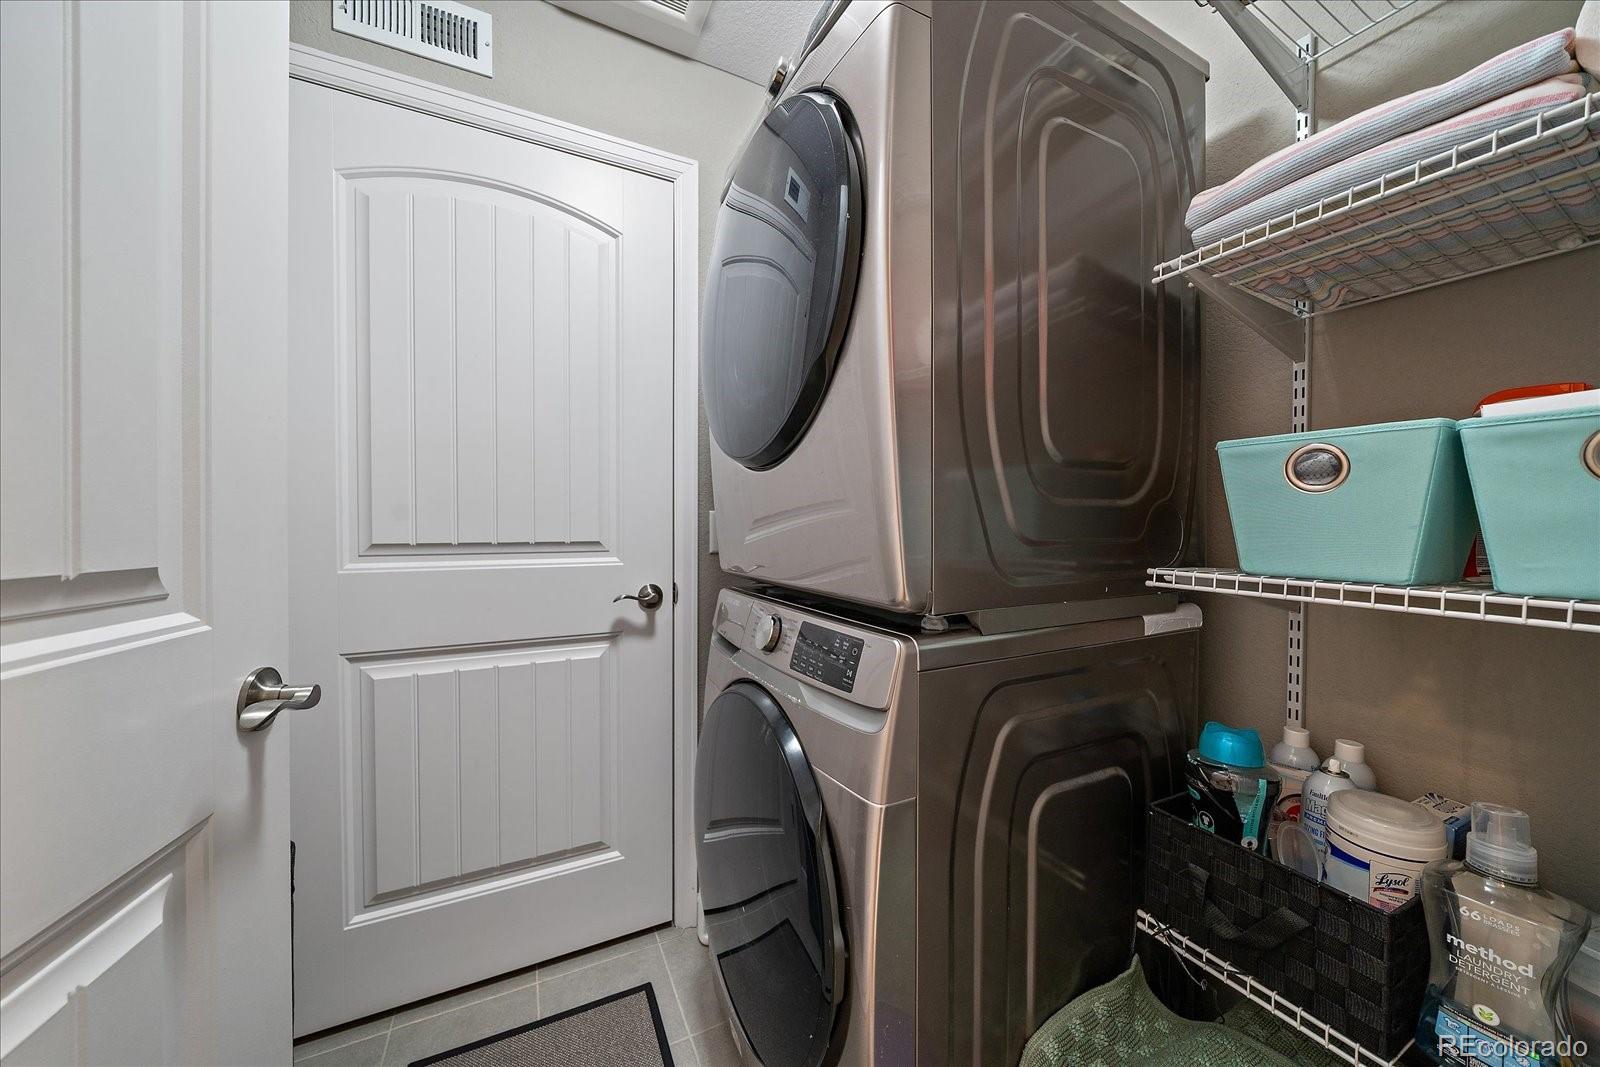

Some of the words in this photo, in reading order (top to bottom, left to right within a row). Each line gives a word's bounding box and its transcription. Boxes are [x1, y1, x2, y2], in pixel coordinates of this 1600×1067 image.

[1375, 874, 1410, 887] Lysol
[1459, 906, 1481, 921] 66
[1483, 913, 1520, 932] LOADS
[1446, 933, 1534, 978] method
[1456, 950, 1522, 983] LAUNDRY
[1449, 954, 1531, 995] DETERGENT
